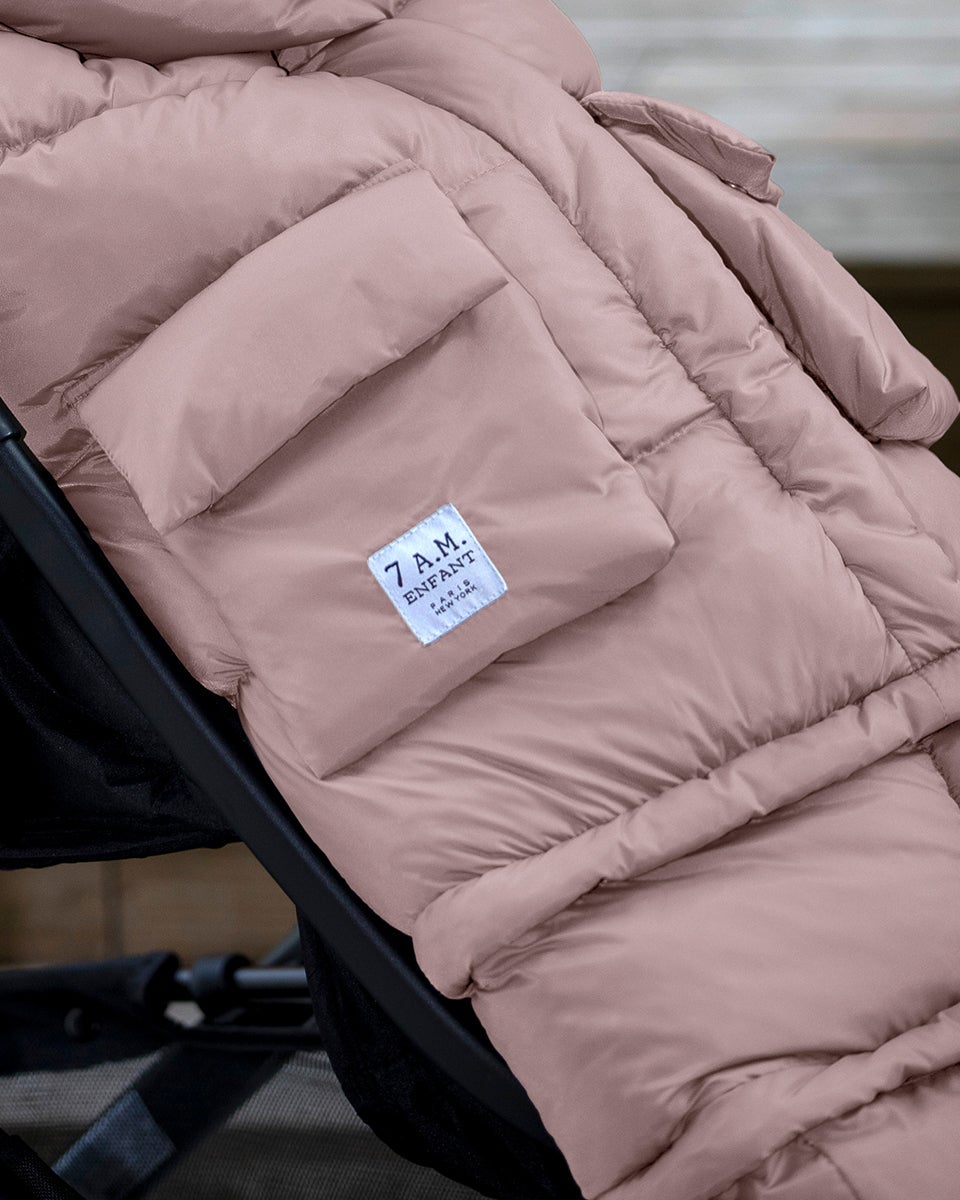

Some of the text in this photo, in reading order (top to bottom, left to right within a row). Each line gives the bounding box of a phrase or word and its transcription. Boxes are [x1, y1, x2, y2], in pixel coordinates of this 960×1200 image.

[384, 532, 467, 587] 7 A.M.
[403, 550, 475, 605] ENFANT
[430, 579, 470, 610] PARIS
